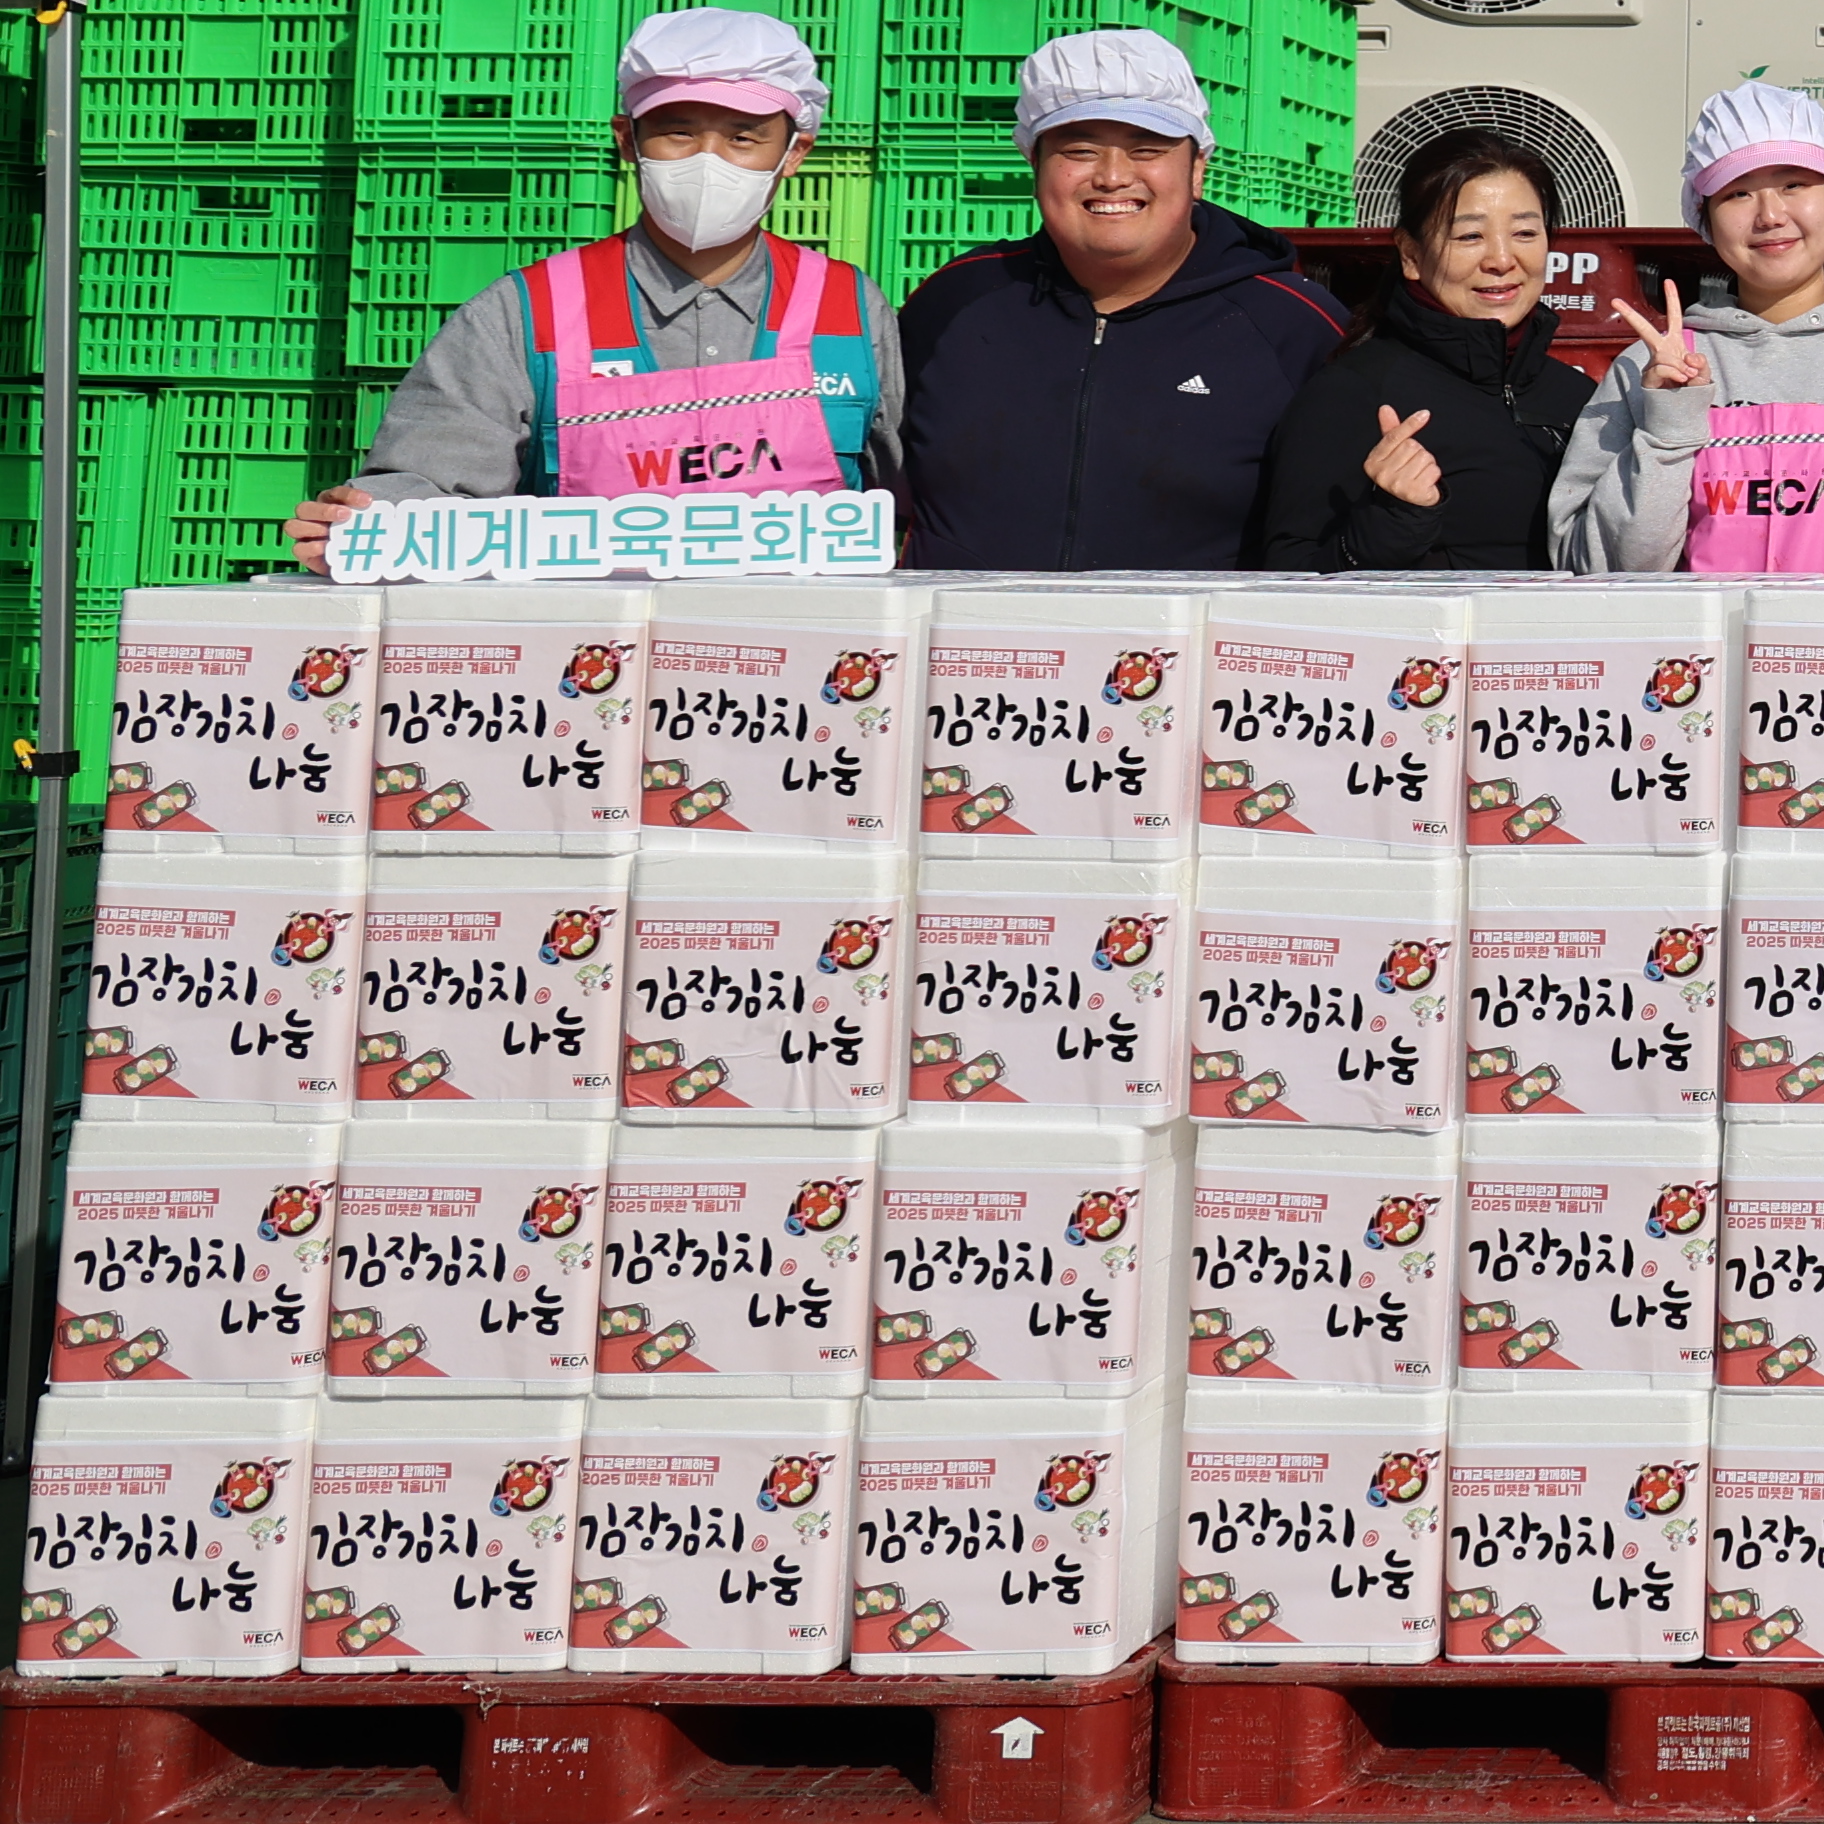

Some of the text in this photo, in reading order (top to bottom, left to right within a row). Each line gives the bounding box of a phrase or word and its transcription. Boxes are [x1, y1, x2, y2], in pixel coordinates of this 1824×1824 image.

[1545, 252, 1599, 285] PP
[812, 376, 857, 396] ECA
[1177, 384, 1211, 395] adidas
[626, 437, 782, 488] WECA
[337, 500, 883, 573] #세계교육문화원
[384, 662, 423, 674] 2025
[381, 690, 546, 743] 김장김치
[523, 740, 604, 789] 나눔
[591, 809, 628, 820] WECA
[919, 932, 957, 944] 2025
[917, 960, 1080, 1014] 김장김치
[1058, 1013, 1138, 1062] 나눔
[1125, 1082, 1162, 1094] WECA
[607, 1201, 646, 1213] 2025
[606, 1228, 771, 1284] 김장김치
[749, 1278, 831, 1328] 나눔
[818, 1349, 856, 1359] WECA
[1452, 1485, 1489, 1496] 2025
[1451, 1512, 1614, 1567] 김장김치
[1593, 1562, 1673, 1611] 나눔
[1663, 1632, 1699, 1642] WECA
